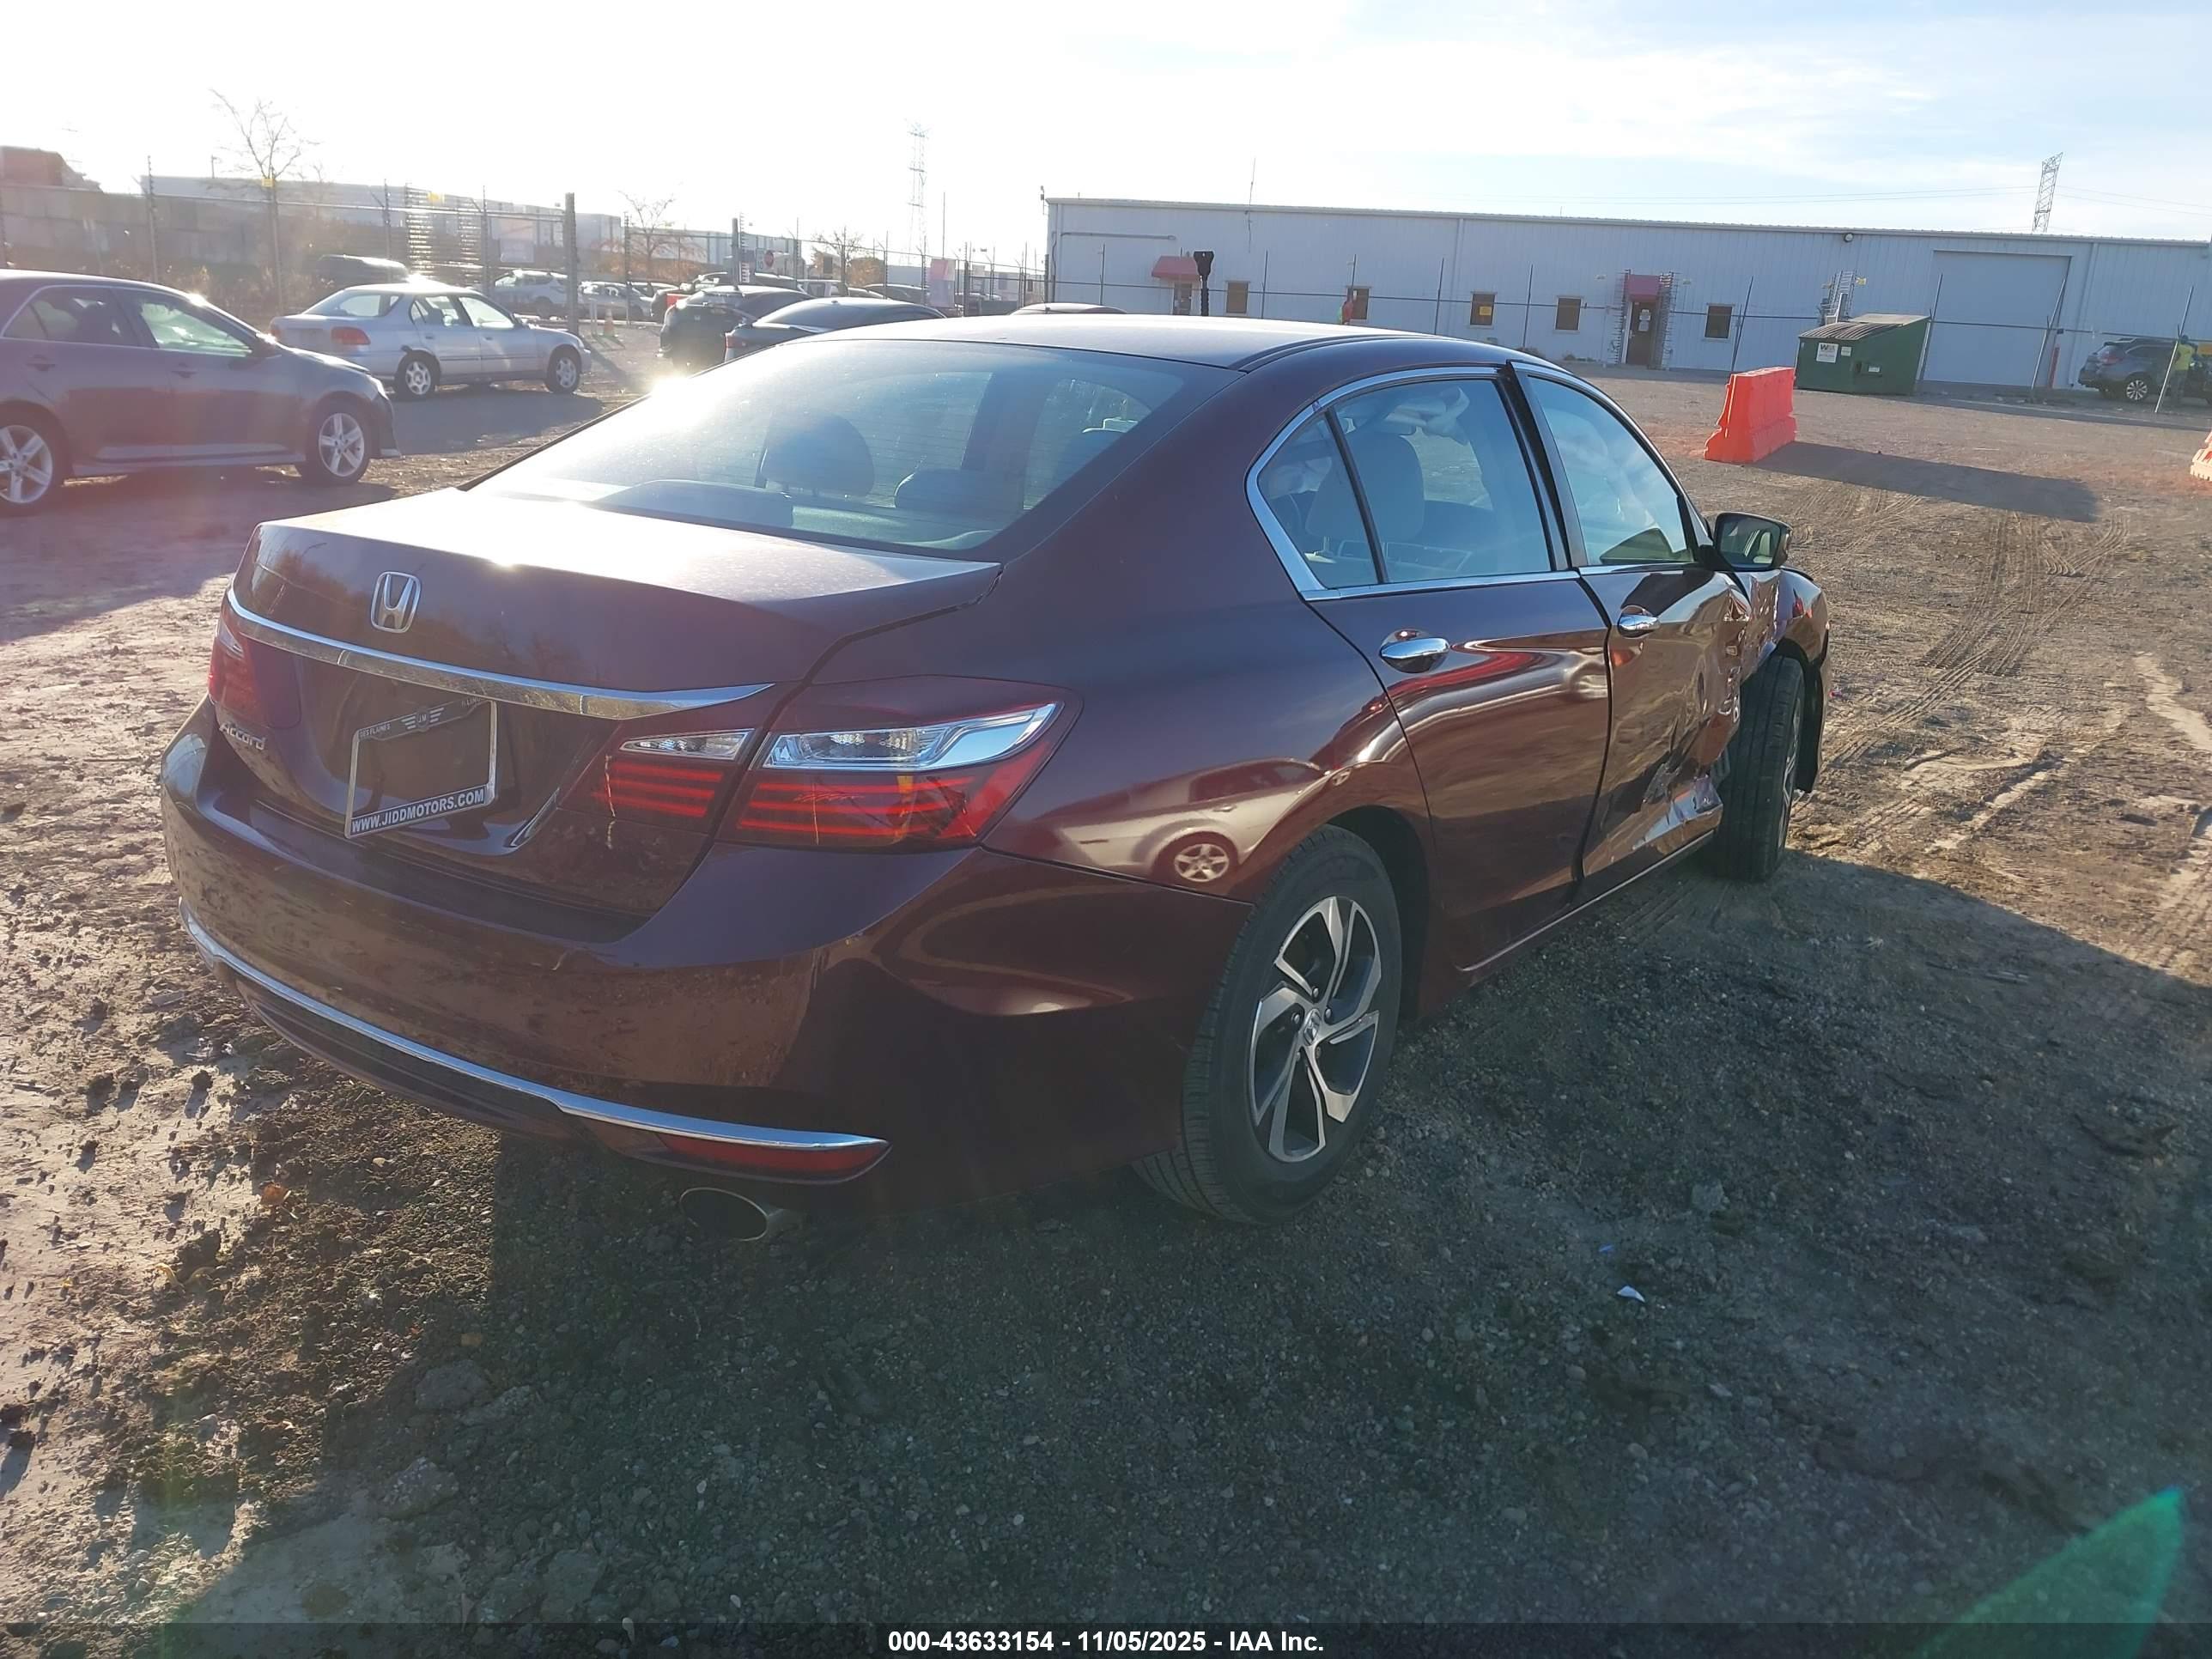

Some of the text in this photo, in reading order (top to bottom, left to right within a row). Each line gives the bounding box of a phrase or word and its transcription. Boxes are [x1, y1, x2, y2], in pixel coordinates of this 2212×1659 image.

[418, 714, 427, 723] JM
[218, 721, 265, 750] Accord
[351, 788, 484, 833] WWW.JIDDMOTORS.COM
